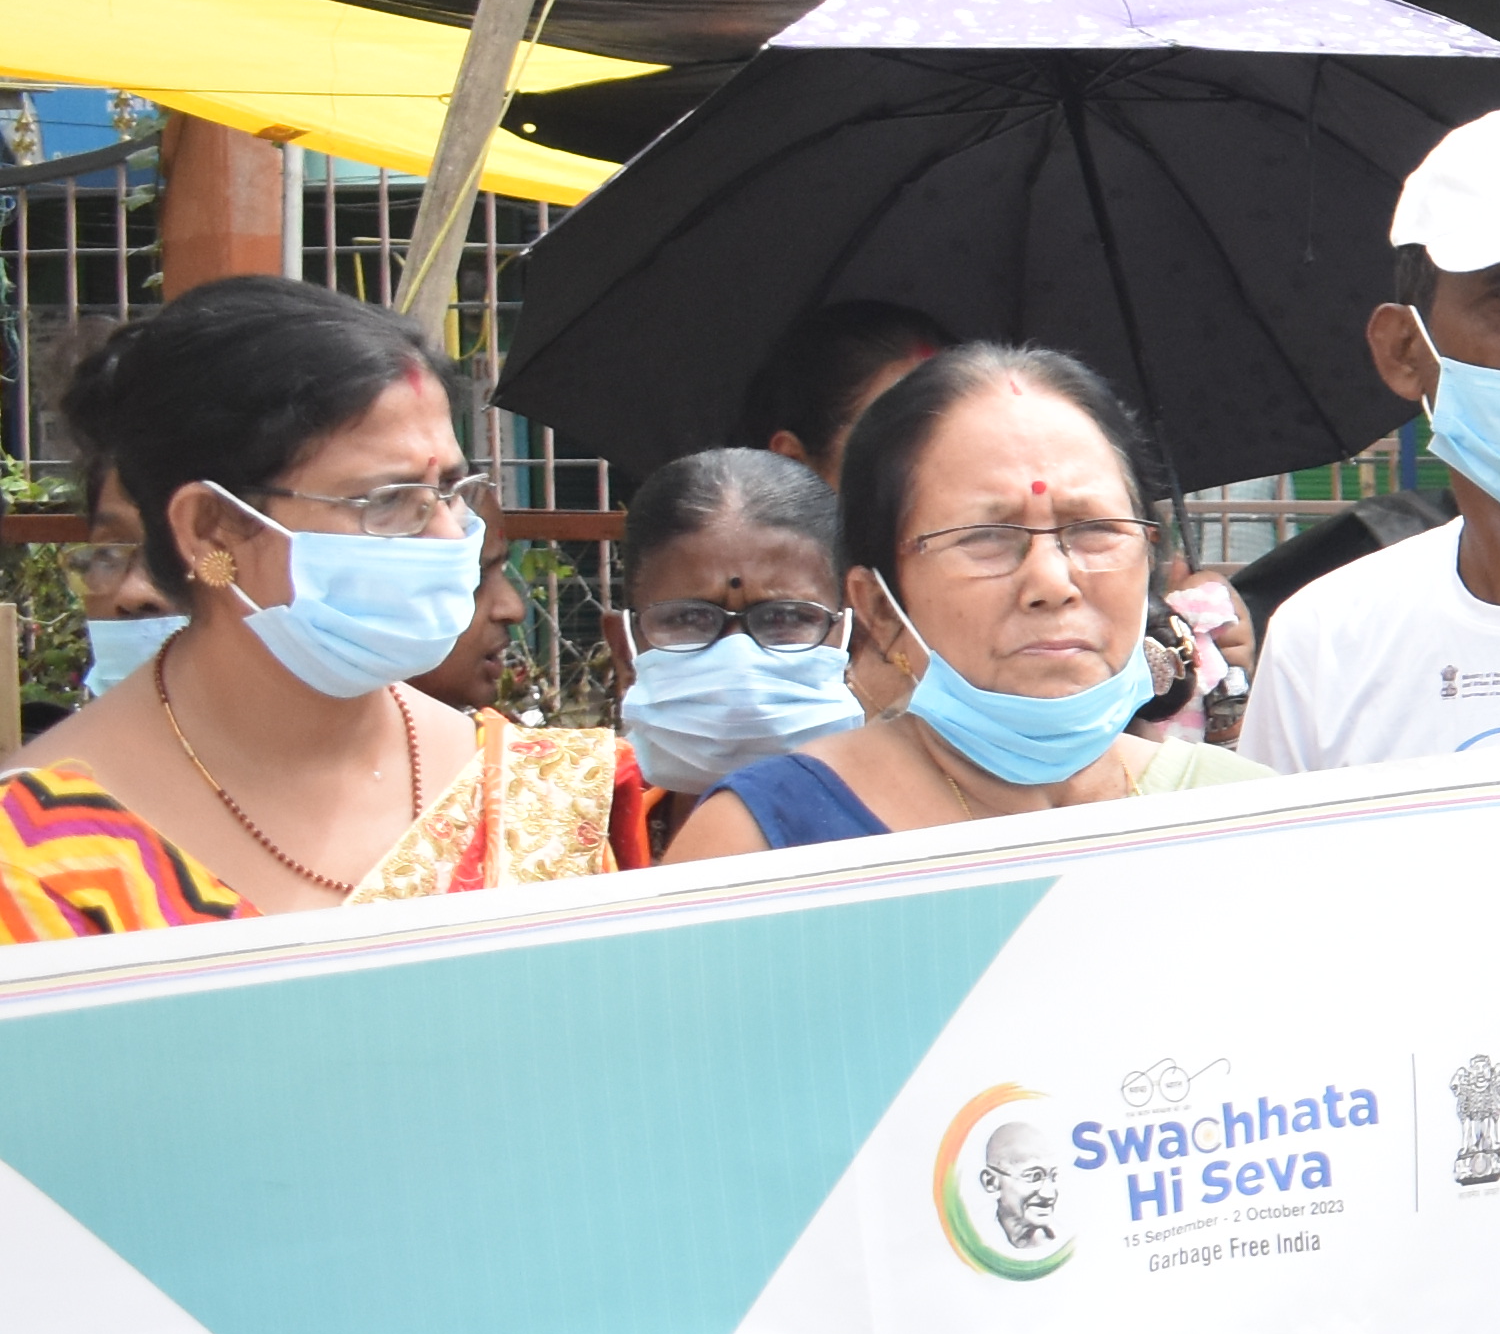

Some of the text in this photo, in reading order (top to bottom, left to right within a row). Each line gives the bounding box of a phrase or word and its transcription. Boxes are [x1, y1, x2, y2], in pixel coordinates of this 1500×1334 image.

[1072, 1085, 1380, 1170] Swachhata
[1127, 1151, 1332, 1221] Hi Seva
[1124, 1234, 1140, 1248] 15
[1144, 1215, 1218, 1245] September
[1233, 1209, 1241, 1223] 2
[1247, 1202, 1305, 1222] October
[1310, 1199, 1345, 1215] 2023
[1149, 1231, 1321, 1273] Garbage Free India
